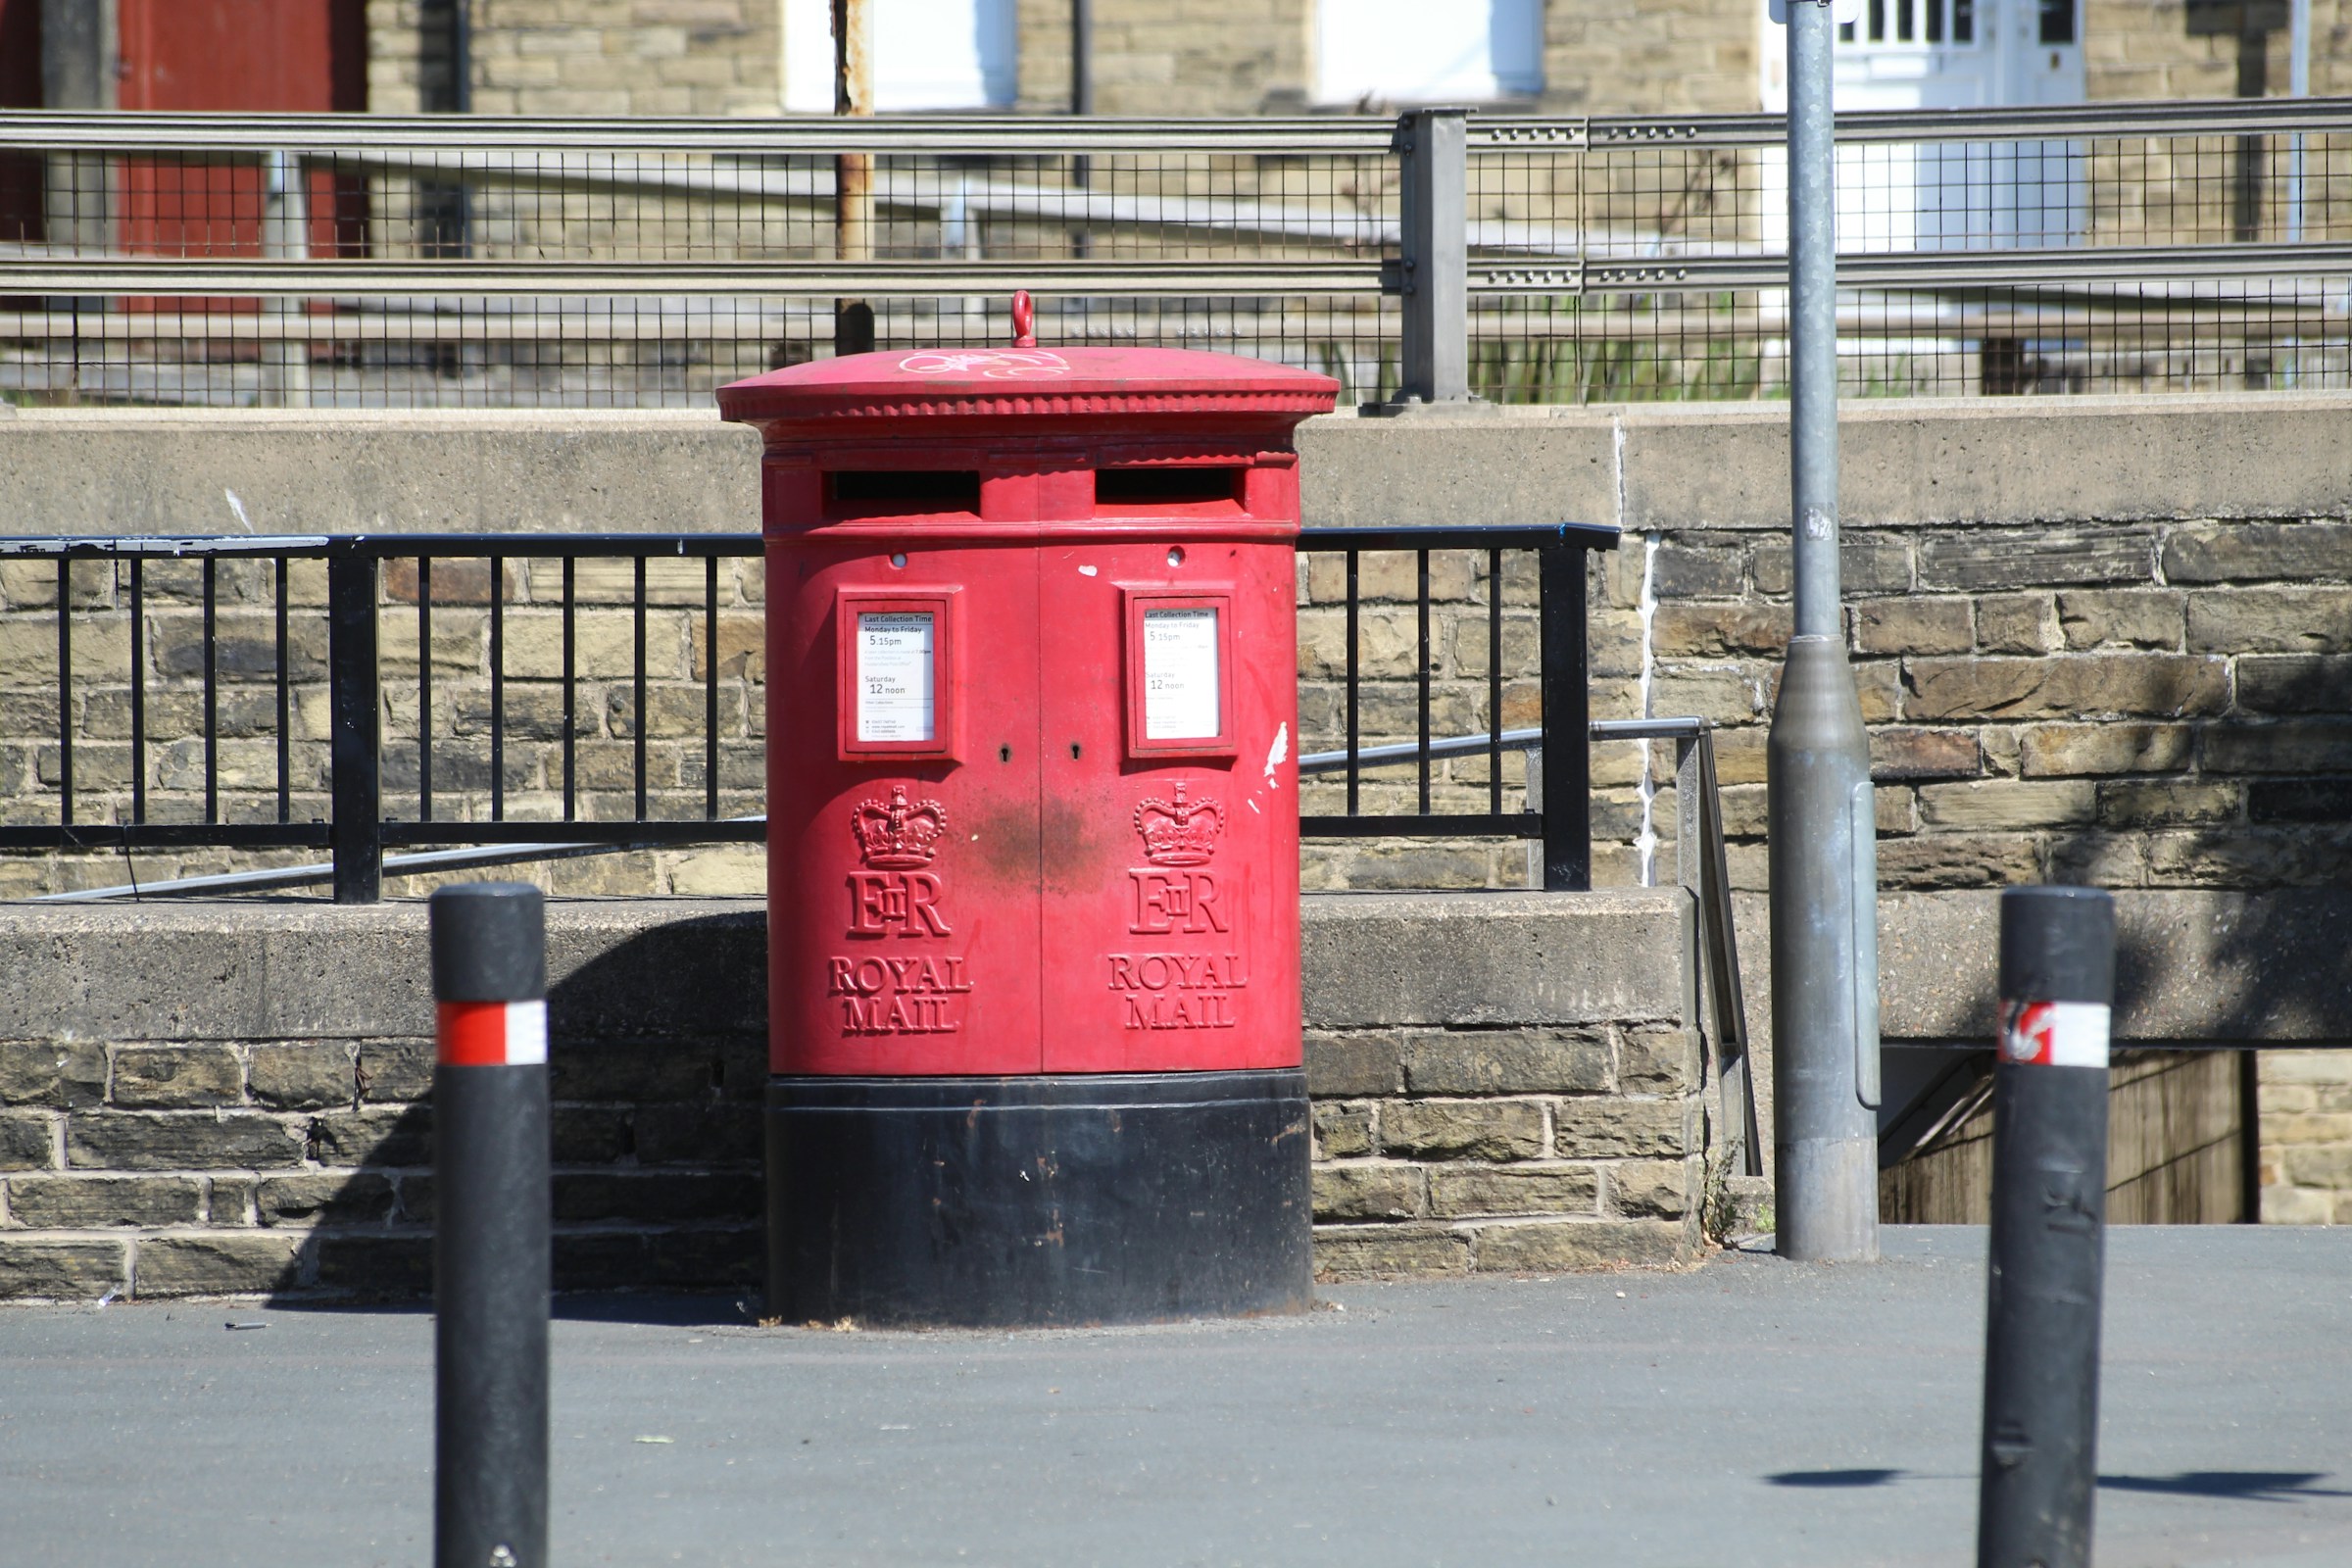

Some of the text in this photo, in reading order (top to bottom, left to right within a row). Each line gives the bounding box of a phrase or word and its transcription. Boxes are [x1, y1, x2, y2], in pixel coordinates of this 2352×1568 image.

[870, 636, 902, 646] 5.15pm
[870, 684, 883, 694] 12
[1150, 680, 1163, 690] 12
[829, 956, 974, 994] ROYAL
[1107, 953, 1248, 991] ROYAL
[842, 996, 959, 1036] MAIL
[1125, 993, 1236, 1030] MAIL
